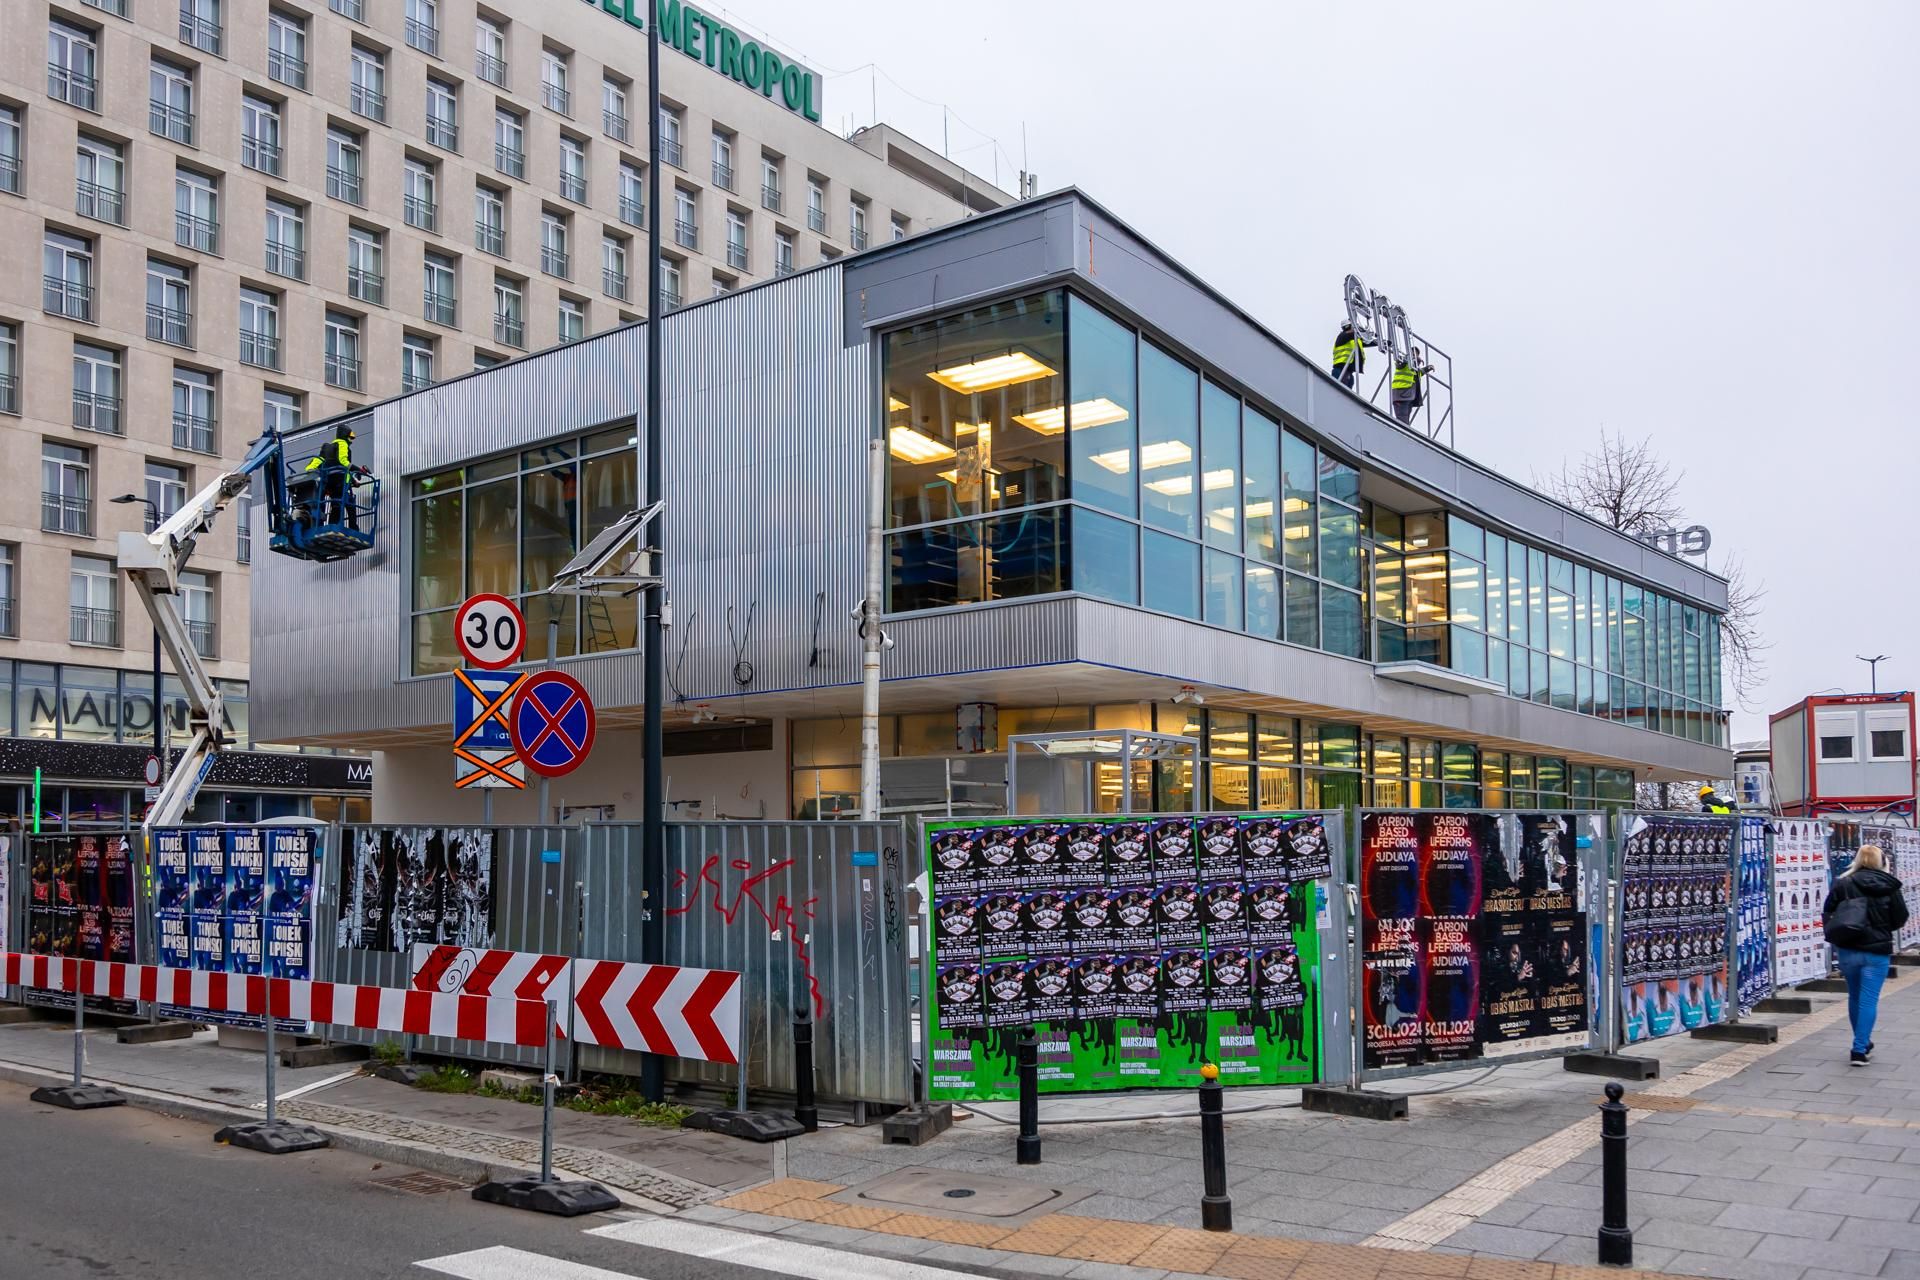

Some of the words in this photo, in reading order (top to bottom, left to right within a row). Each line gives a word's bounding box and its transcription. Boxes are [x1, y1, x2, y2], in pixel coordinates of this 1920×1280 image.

[657, 0, 820, 122] METROPOL
[466, 612, 516, 651] 30
[30, 687, 235, 734] MADON
[1379, 826, 1409, 837] BASED
[1370, 837, 1418, 848] LFEFORMS
[1435, 931, 1464, 943] BASED
[1428, 942, 1471, 953] LFEFORMS
[1037, 1041, 1071, 1053] ARSZAWA
[1120, 1037, 1157, 1048] WARSZAWA
[1219, 1035, 1256, 1047] WARSZAWA
[933, 1050, 972, 1061] WARSZAWA
